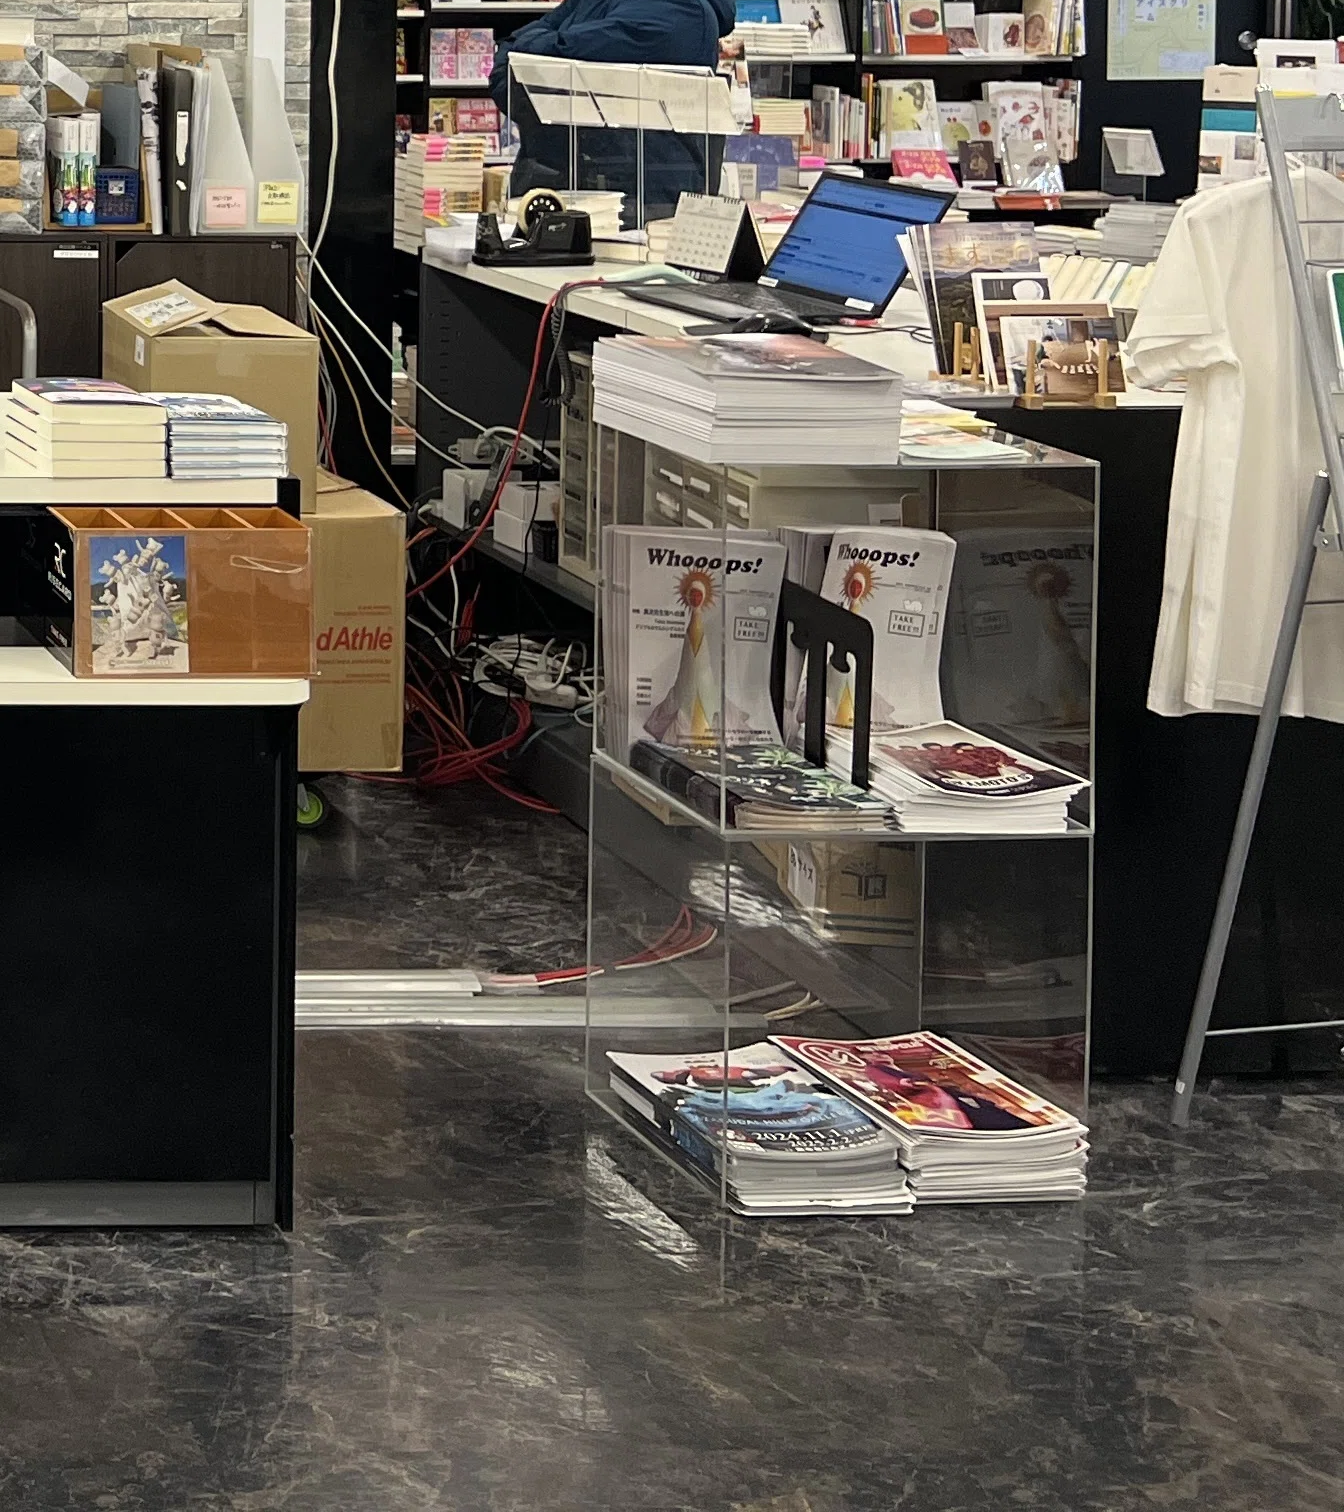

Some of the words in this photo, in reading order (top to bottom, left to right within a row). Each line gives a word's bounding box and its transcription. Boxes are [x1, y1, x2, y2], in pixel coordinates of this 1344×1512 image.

[647, 548, 763, 575] Whooops!
[836, 543, 920, 567] Whooops!
[739, 621, 760, 629] TAKE
[894, 614, 914, 624] TAKE
[335, 625, 393, 652] Athle
